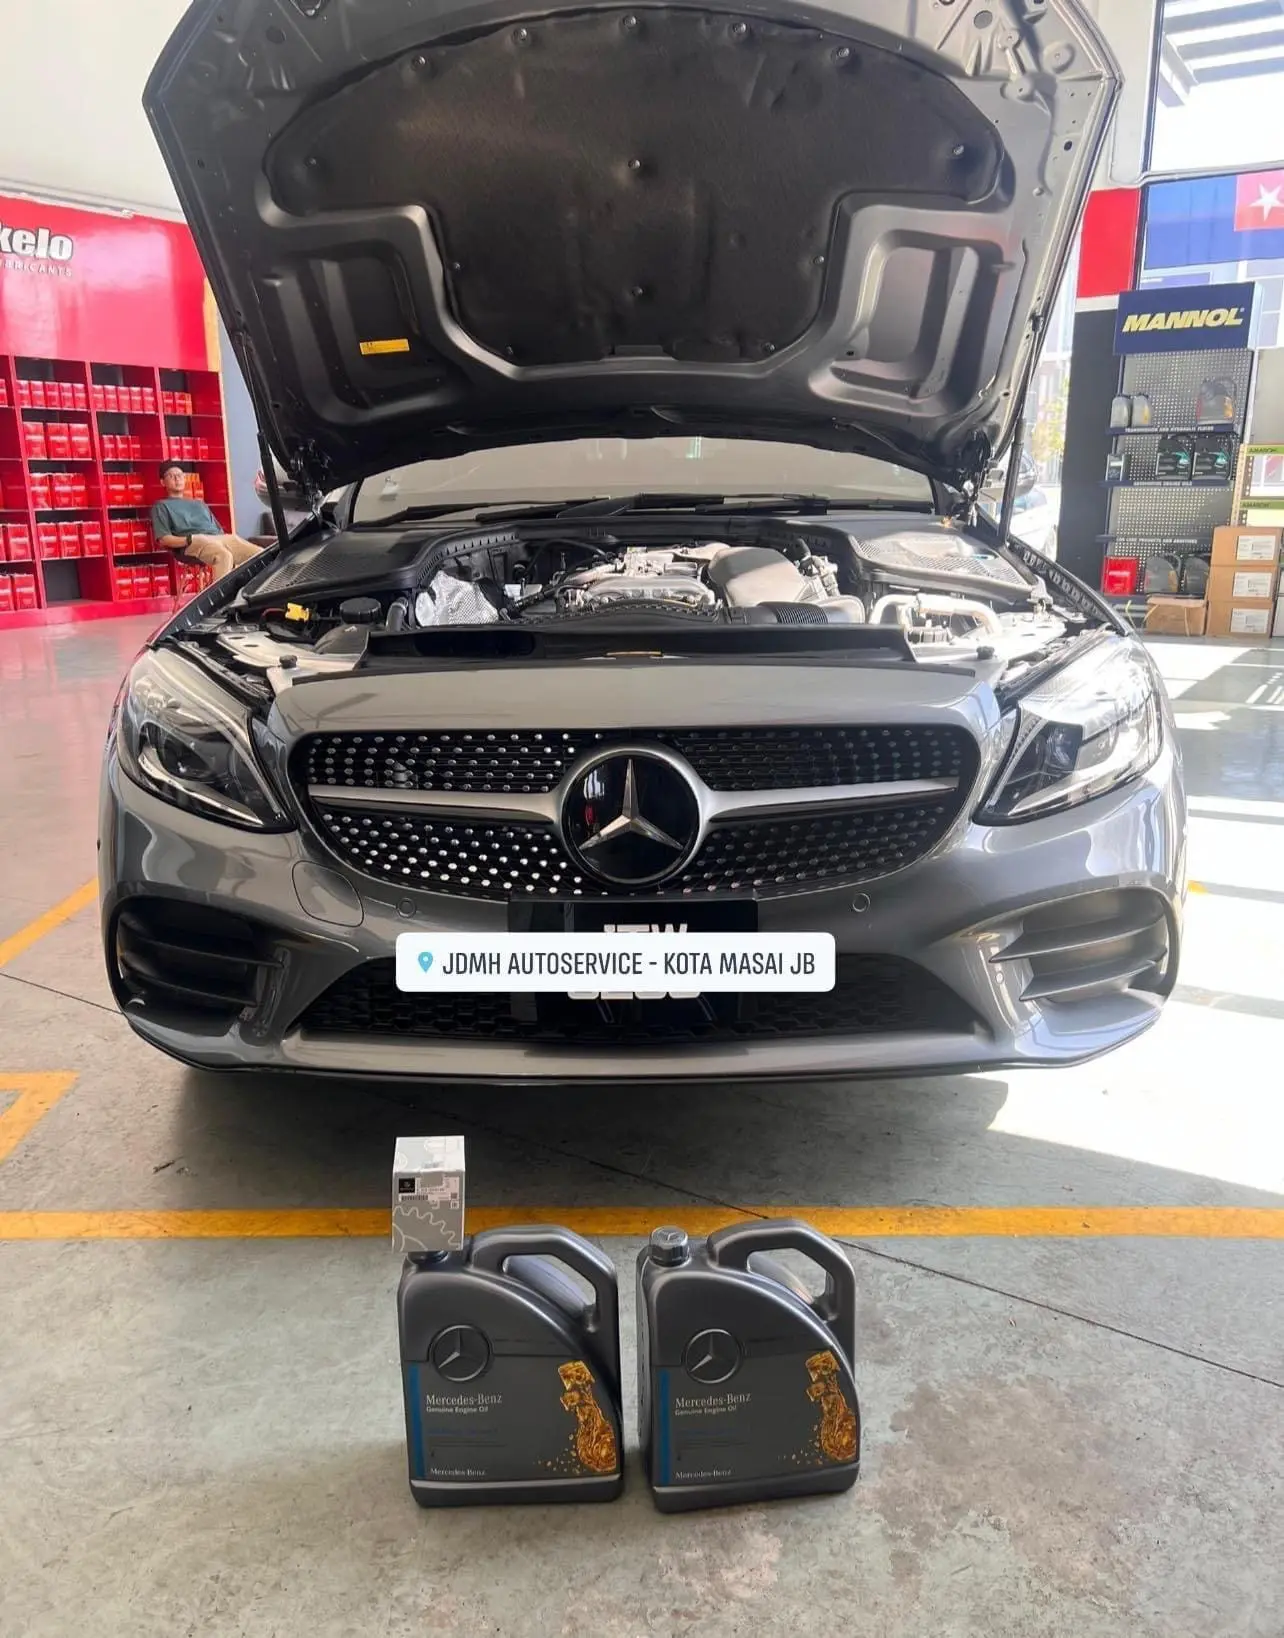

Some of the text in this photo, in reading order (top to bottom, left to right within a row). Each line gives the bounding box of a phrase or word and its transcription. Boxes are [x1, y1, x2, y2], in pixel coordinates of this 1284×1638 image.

[0, 258, 72, 277] BRICANTS
[1122, 307, 1243, 332] MANNOL
[426, 1393, 502, 1405] Mercedes-Benz
[675, 1393, 752, 1408] Mercedes-Benz
[455, 1406, 477, 1414] Engine
